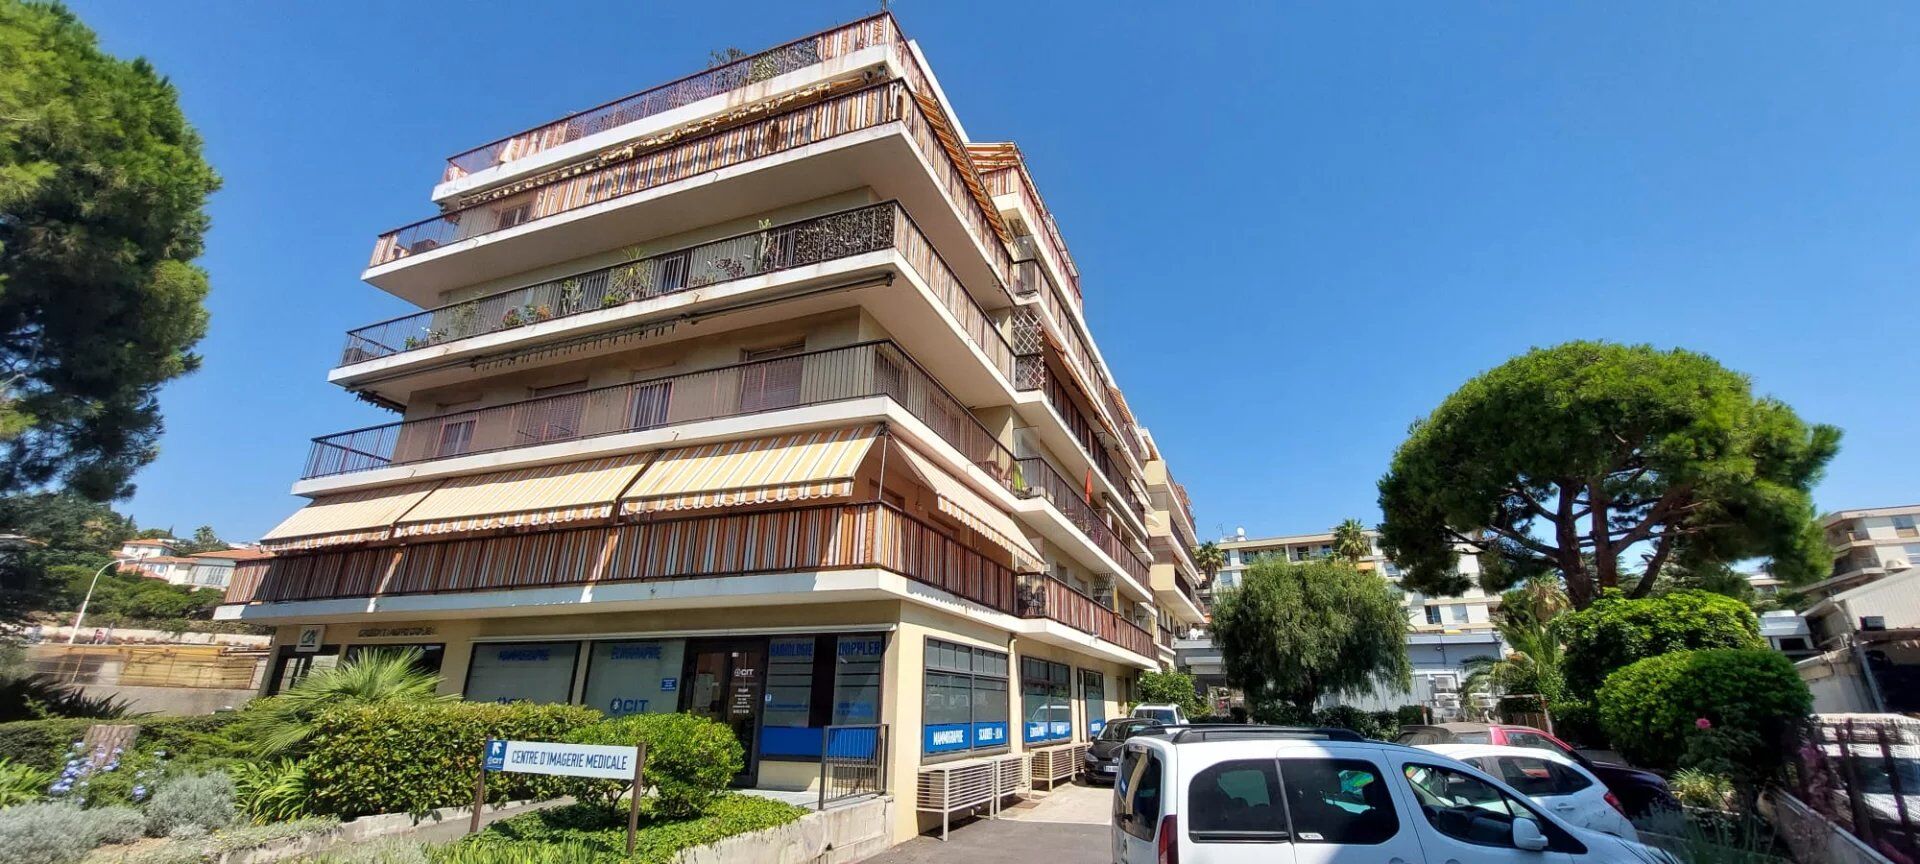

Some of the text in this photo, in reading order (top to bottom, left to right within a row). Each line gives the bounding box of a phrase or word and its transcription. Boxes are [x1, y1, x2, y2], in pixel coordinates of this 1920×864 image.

[838, 641, 880, 656] DOPPLER
[622, 699, 649, 712] CIT
[511, 750, 628, 771] CENTRE D'IMAGERIE MEDICALE
